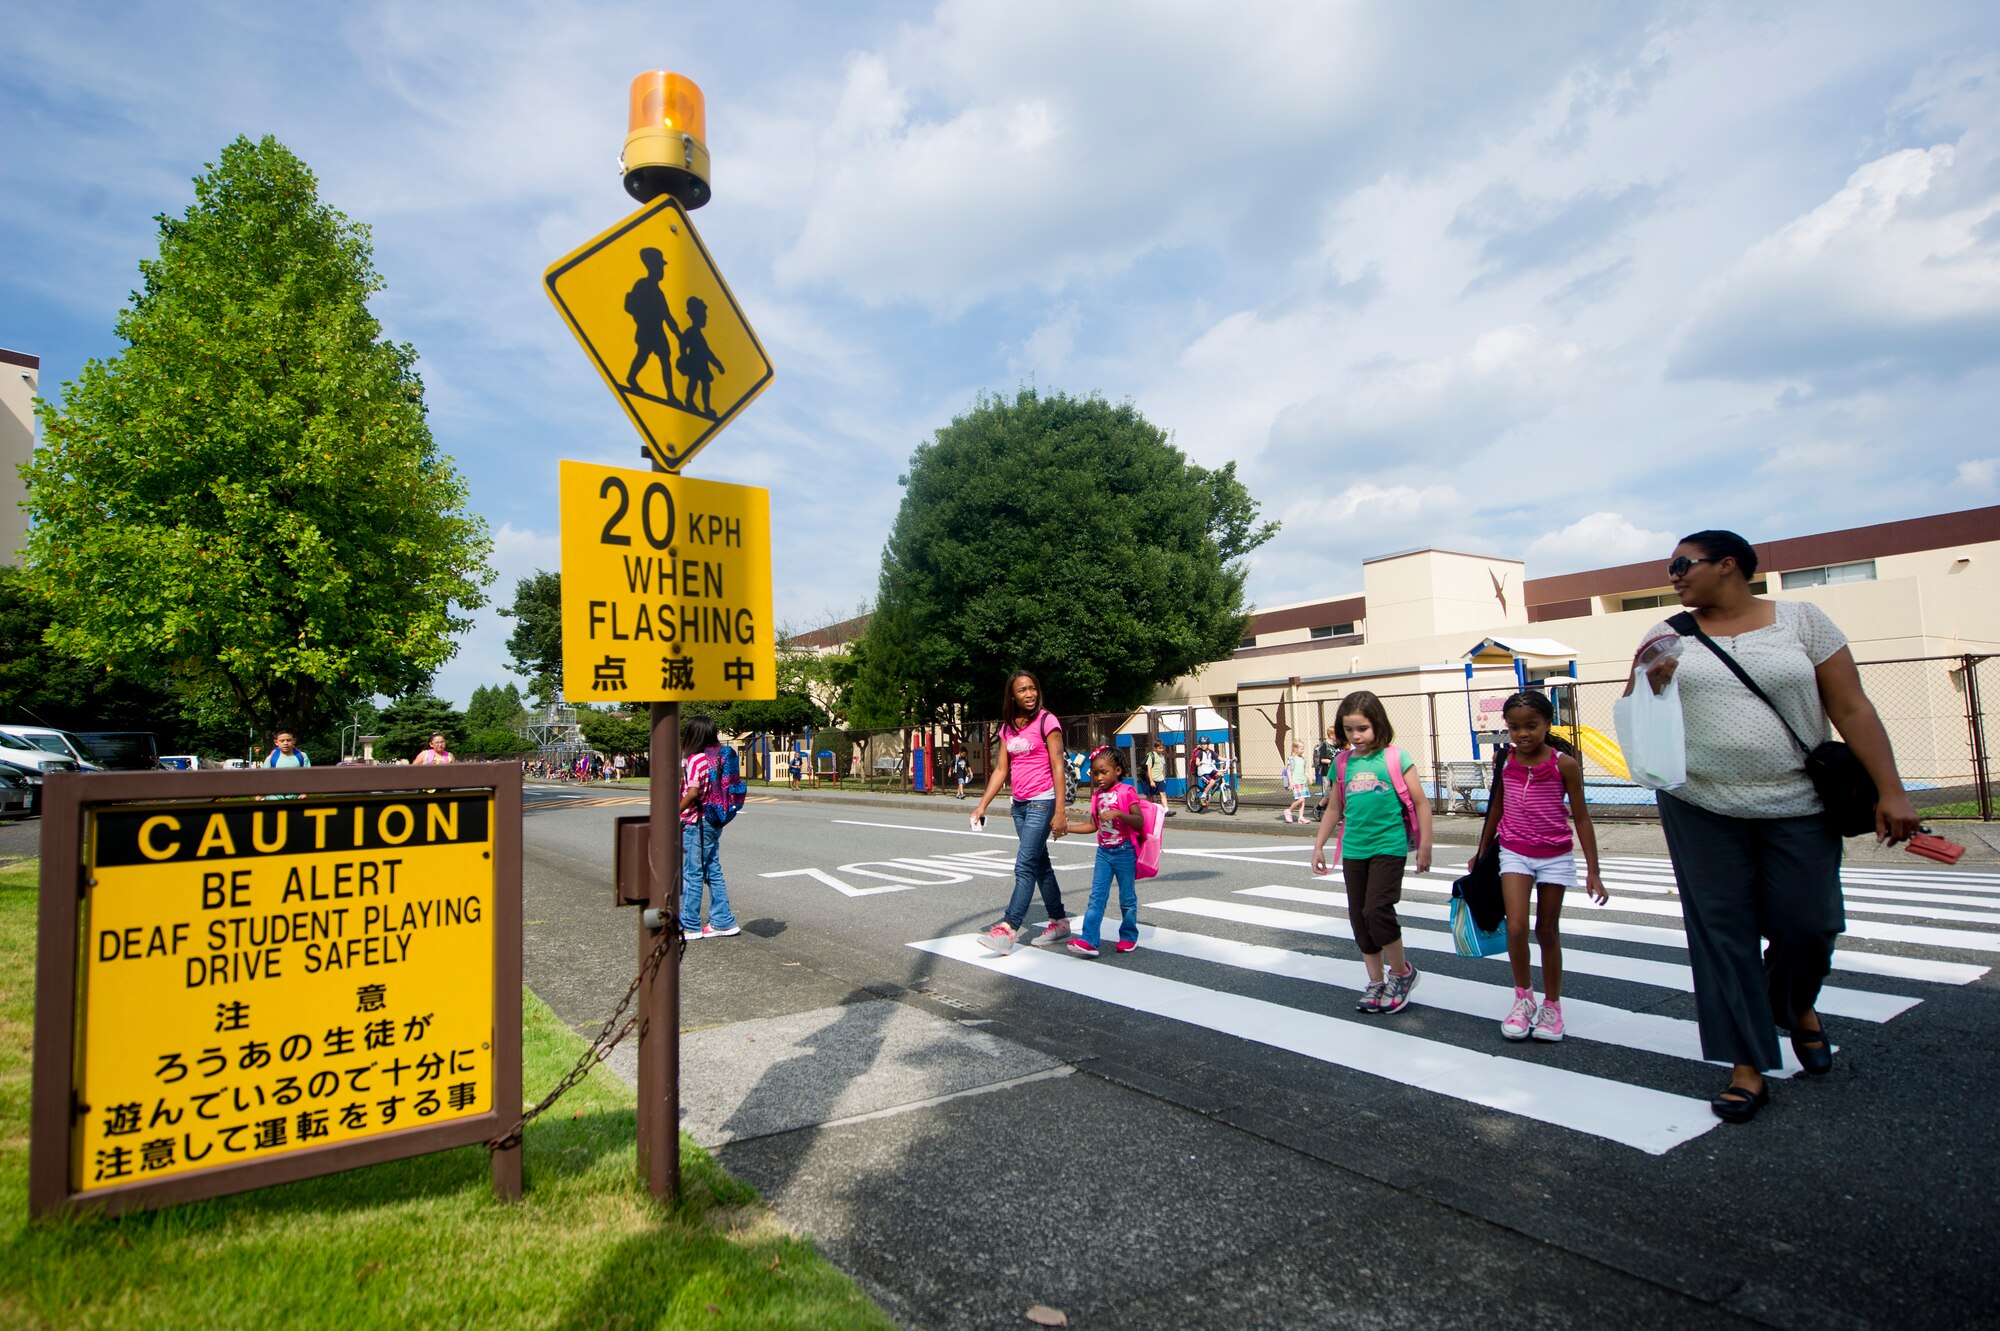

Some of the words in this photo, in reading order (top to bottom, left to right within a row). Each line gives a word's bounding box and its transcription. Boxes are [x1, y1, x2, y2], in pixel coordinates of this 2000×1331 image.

[599, 475, 676, 551] 20
[688, 512, 741, 549] KPH
[623, 555, 723, 599] WHEN
[588, 600, 755, 645] FLASHING
[137, 801, 459, 861] CAUTION
[201, 870, 253, 910] BE
[281, 859, 403, 904] ALERT
[98, 923, 191, 963] DEAF
[206, 909, 349, 951] STUDENT
[364, 896, 482, 935] PLAYING
[185, 948, 282, 989] DRIVE
[303, 934, 412, 974] SAFELY
[153, 1013, 436, 1085] ろうあの生徒が
[102, 1047, 477, 1139] 遊んでいるので十分に
[94, 1081, 478, 1183] 注意して運転をする事
